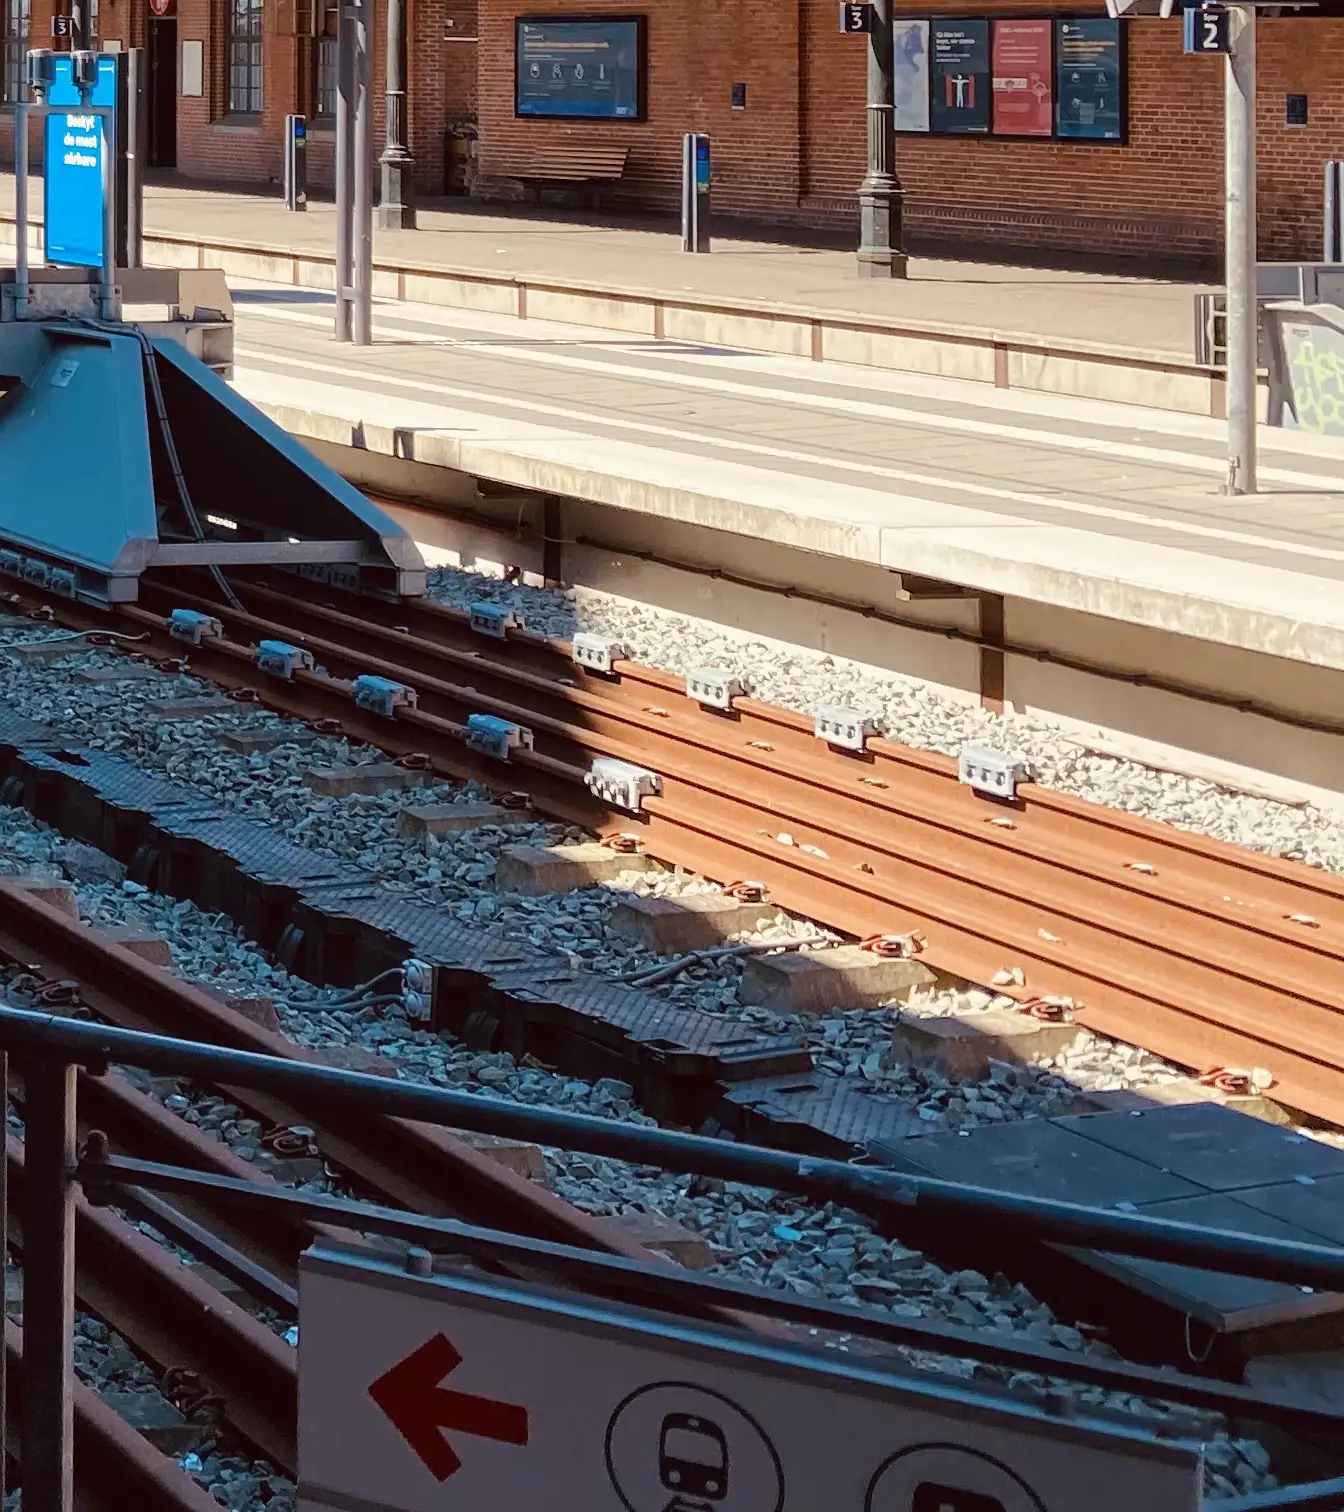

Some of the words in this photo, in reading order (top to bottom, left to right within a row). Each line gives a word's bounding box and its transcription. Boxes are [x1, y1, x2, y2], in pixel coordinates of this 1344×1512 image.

[58, 22, 67, 34] 3
[852, 11, 863, 29] 3
[1202, 23, 1219, 49] 2
